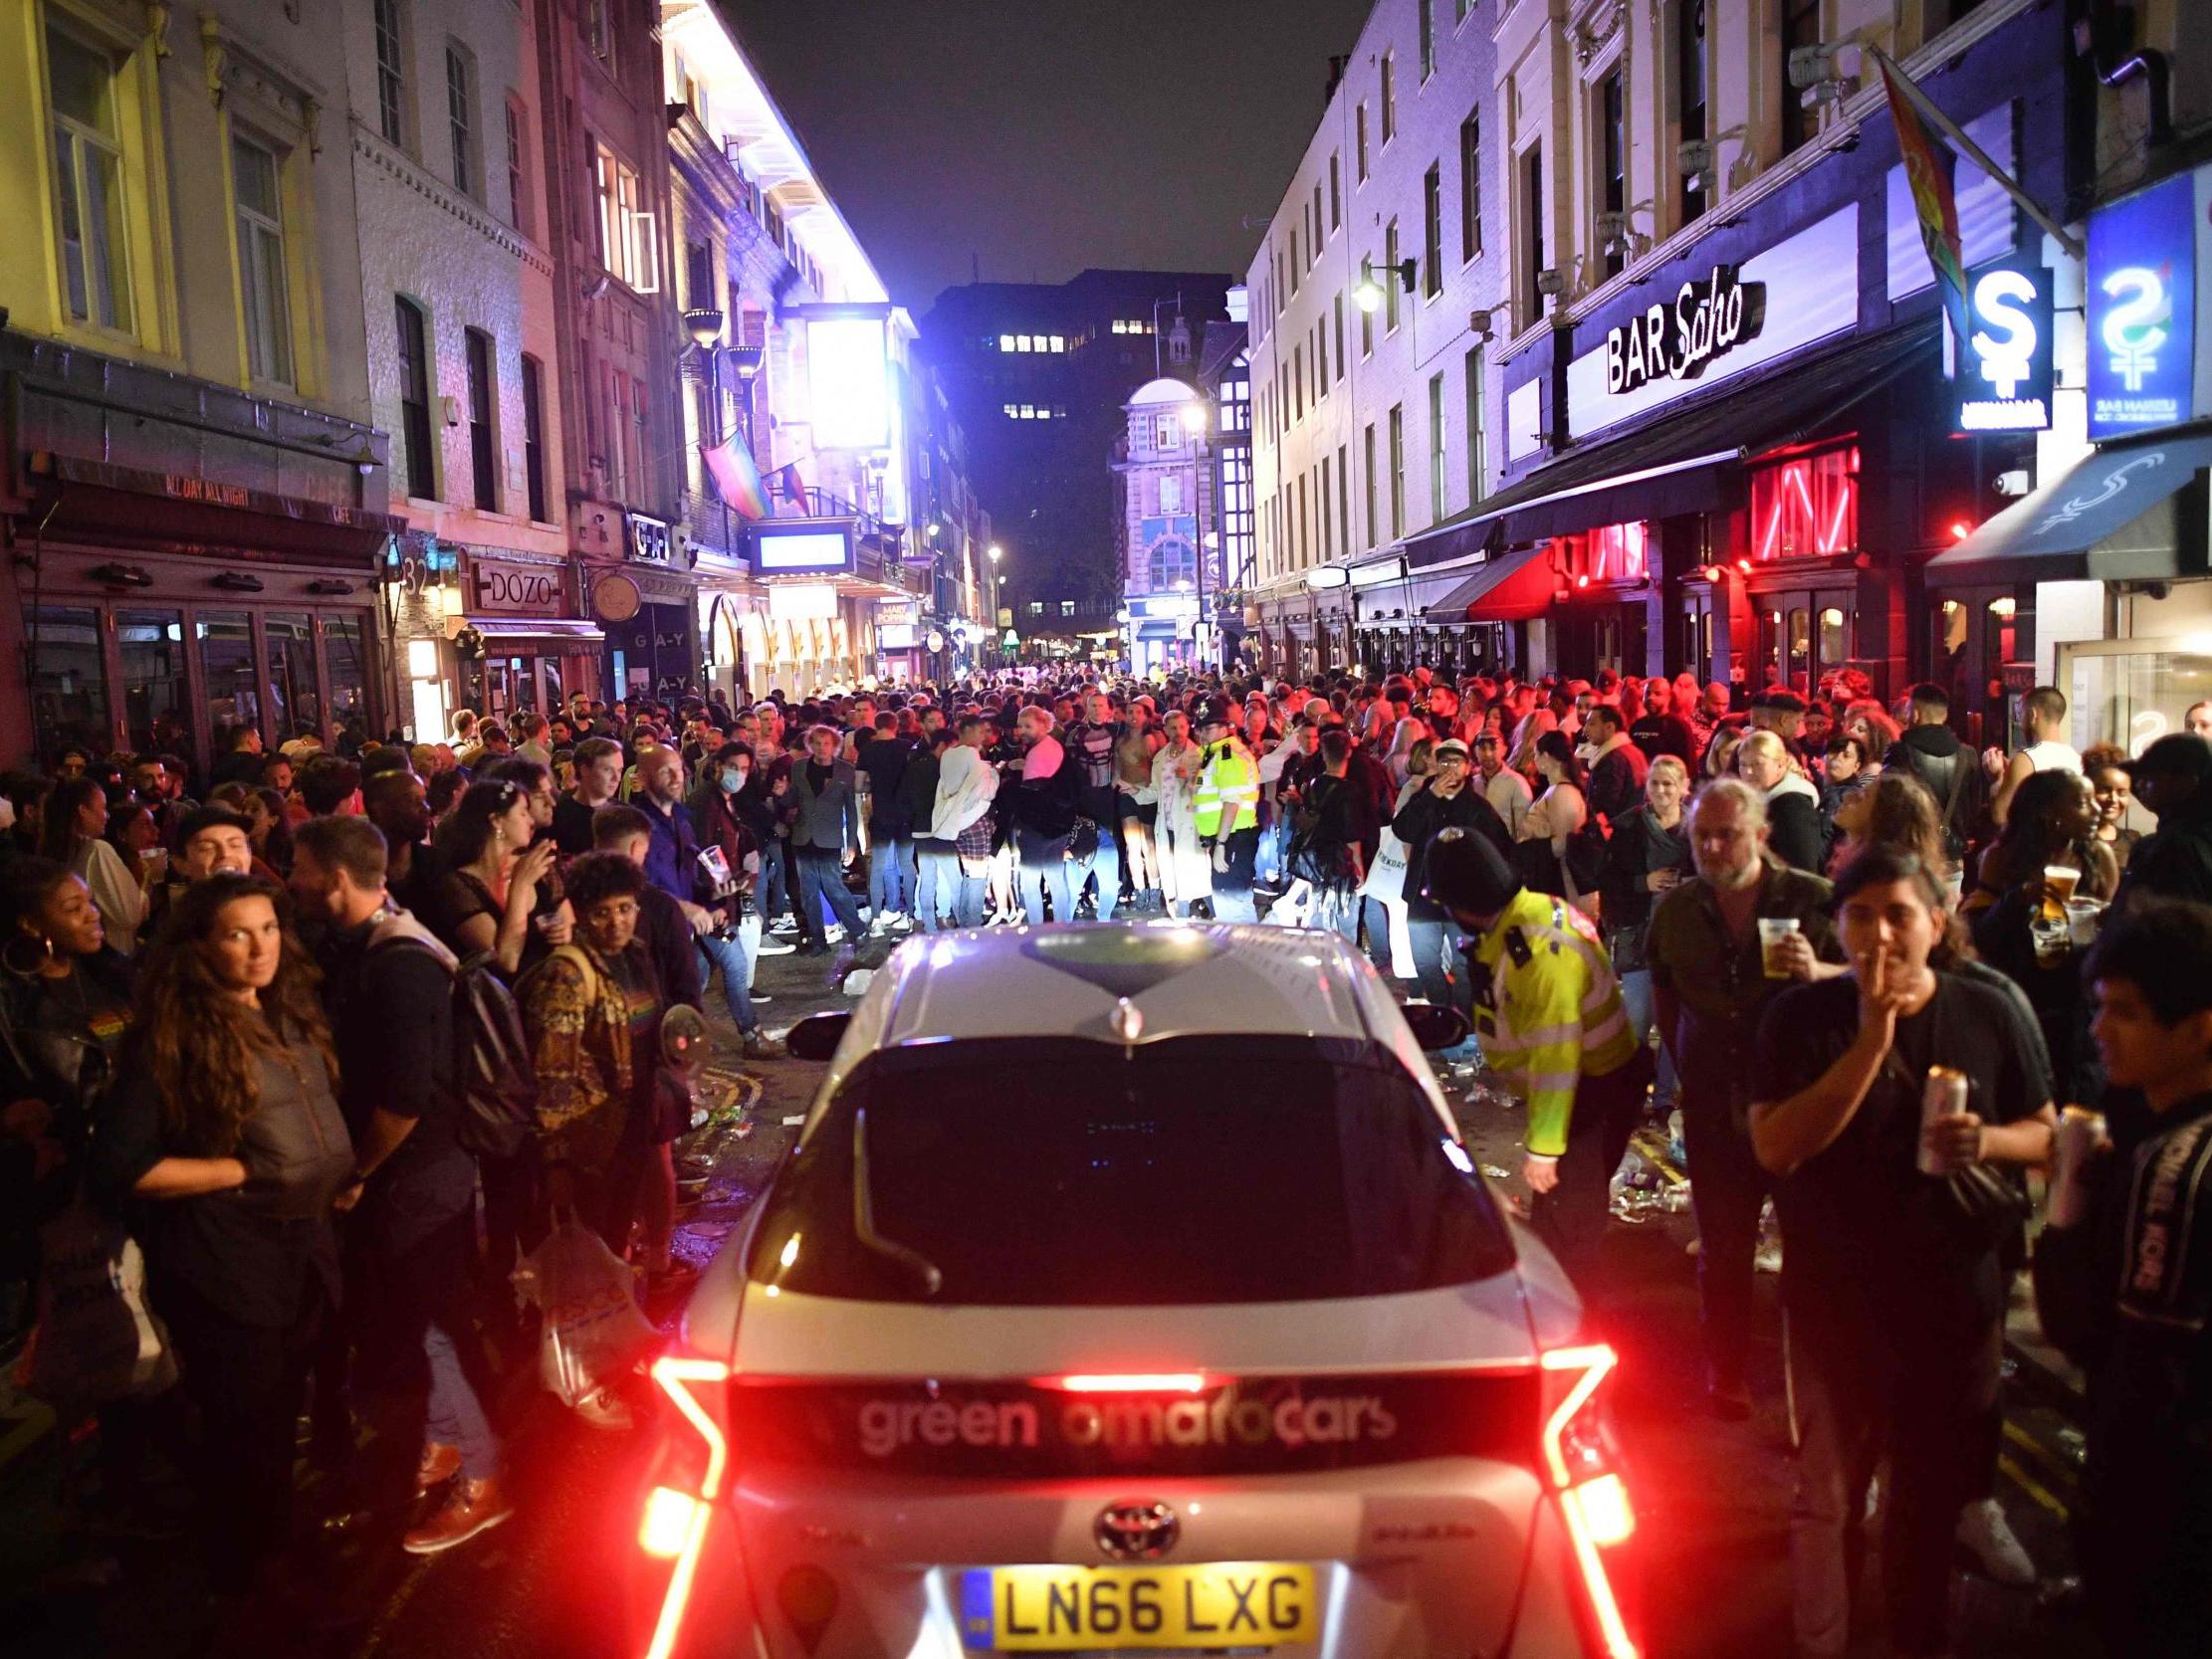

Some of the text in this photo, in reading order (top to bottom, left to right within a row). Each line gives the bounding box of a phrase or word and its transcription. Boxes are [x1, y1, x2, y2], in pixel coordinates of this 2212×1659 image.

[1608, 266, 1742, 394] BAR Soho
[166, 474, 249, 508] ALL DAY ALL NIGHT
[490, 572, 553, 605] DOZO
[877, 613, 913, 623] POPPIN
[882, 604, 908, 615] MARY
[859, 1400, 1038, 1456] green
[1273, 1393, 1397, 1446] cars
[1005, 1576, 1302, 1635] LN66 LXG
